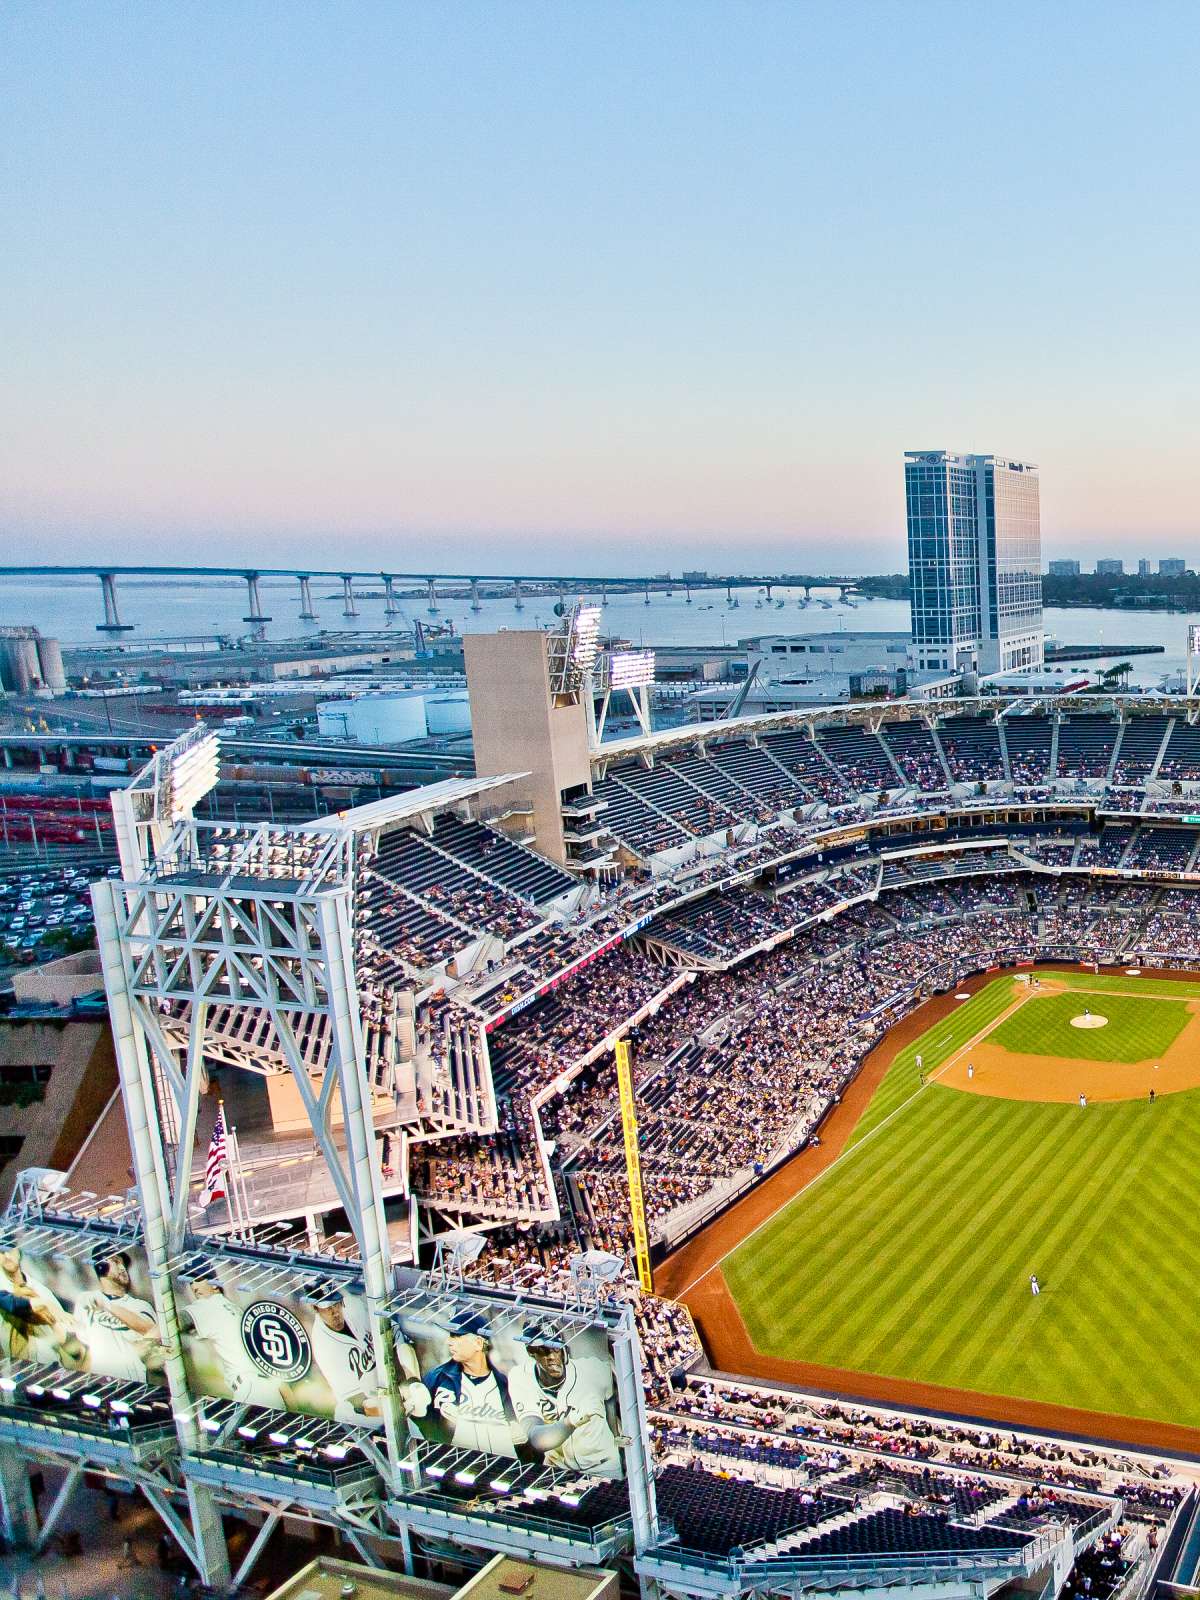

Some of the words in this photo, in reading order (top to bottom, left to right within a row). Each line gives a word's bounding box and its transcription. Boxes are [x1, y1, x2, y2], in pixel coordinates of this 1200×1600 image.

[244, 1314, 255, 1333] SAN
[252, 1305, 277, 1316] DIEGO
[279, 1309, 307, 1344] PADRES
